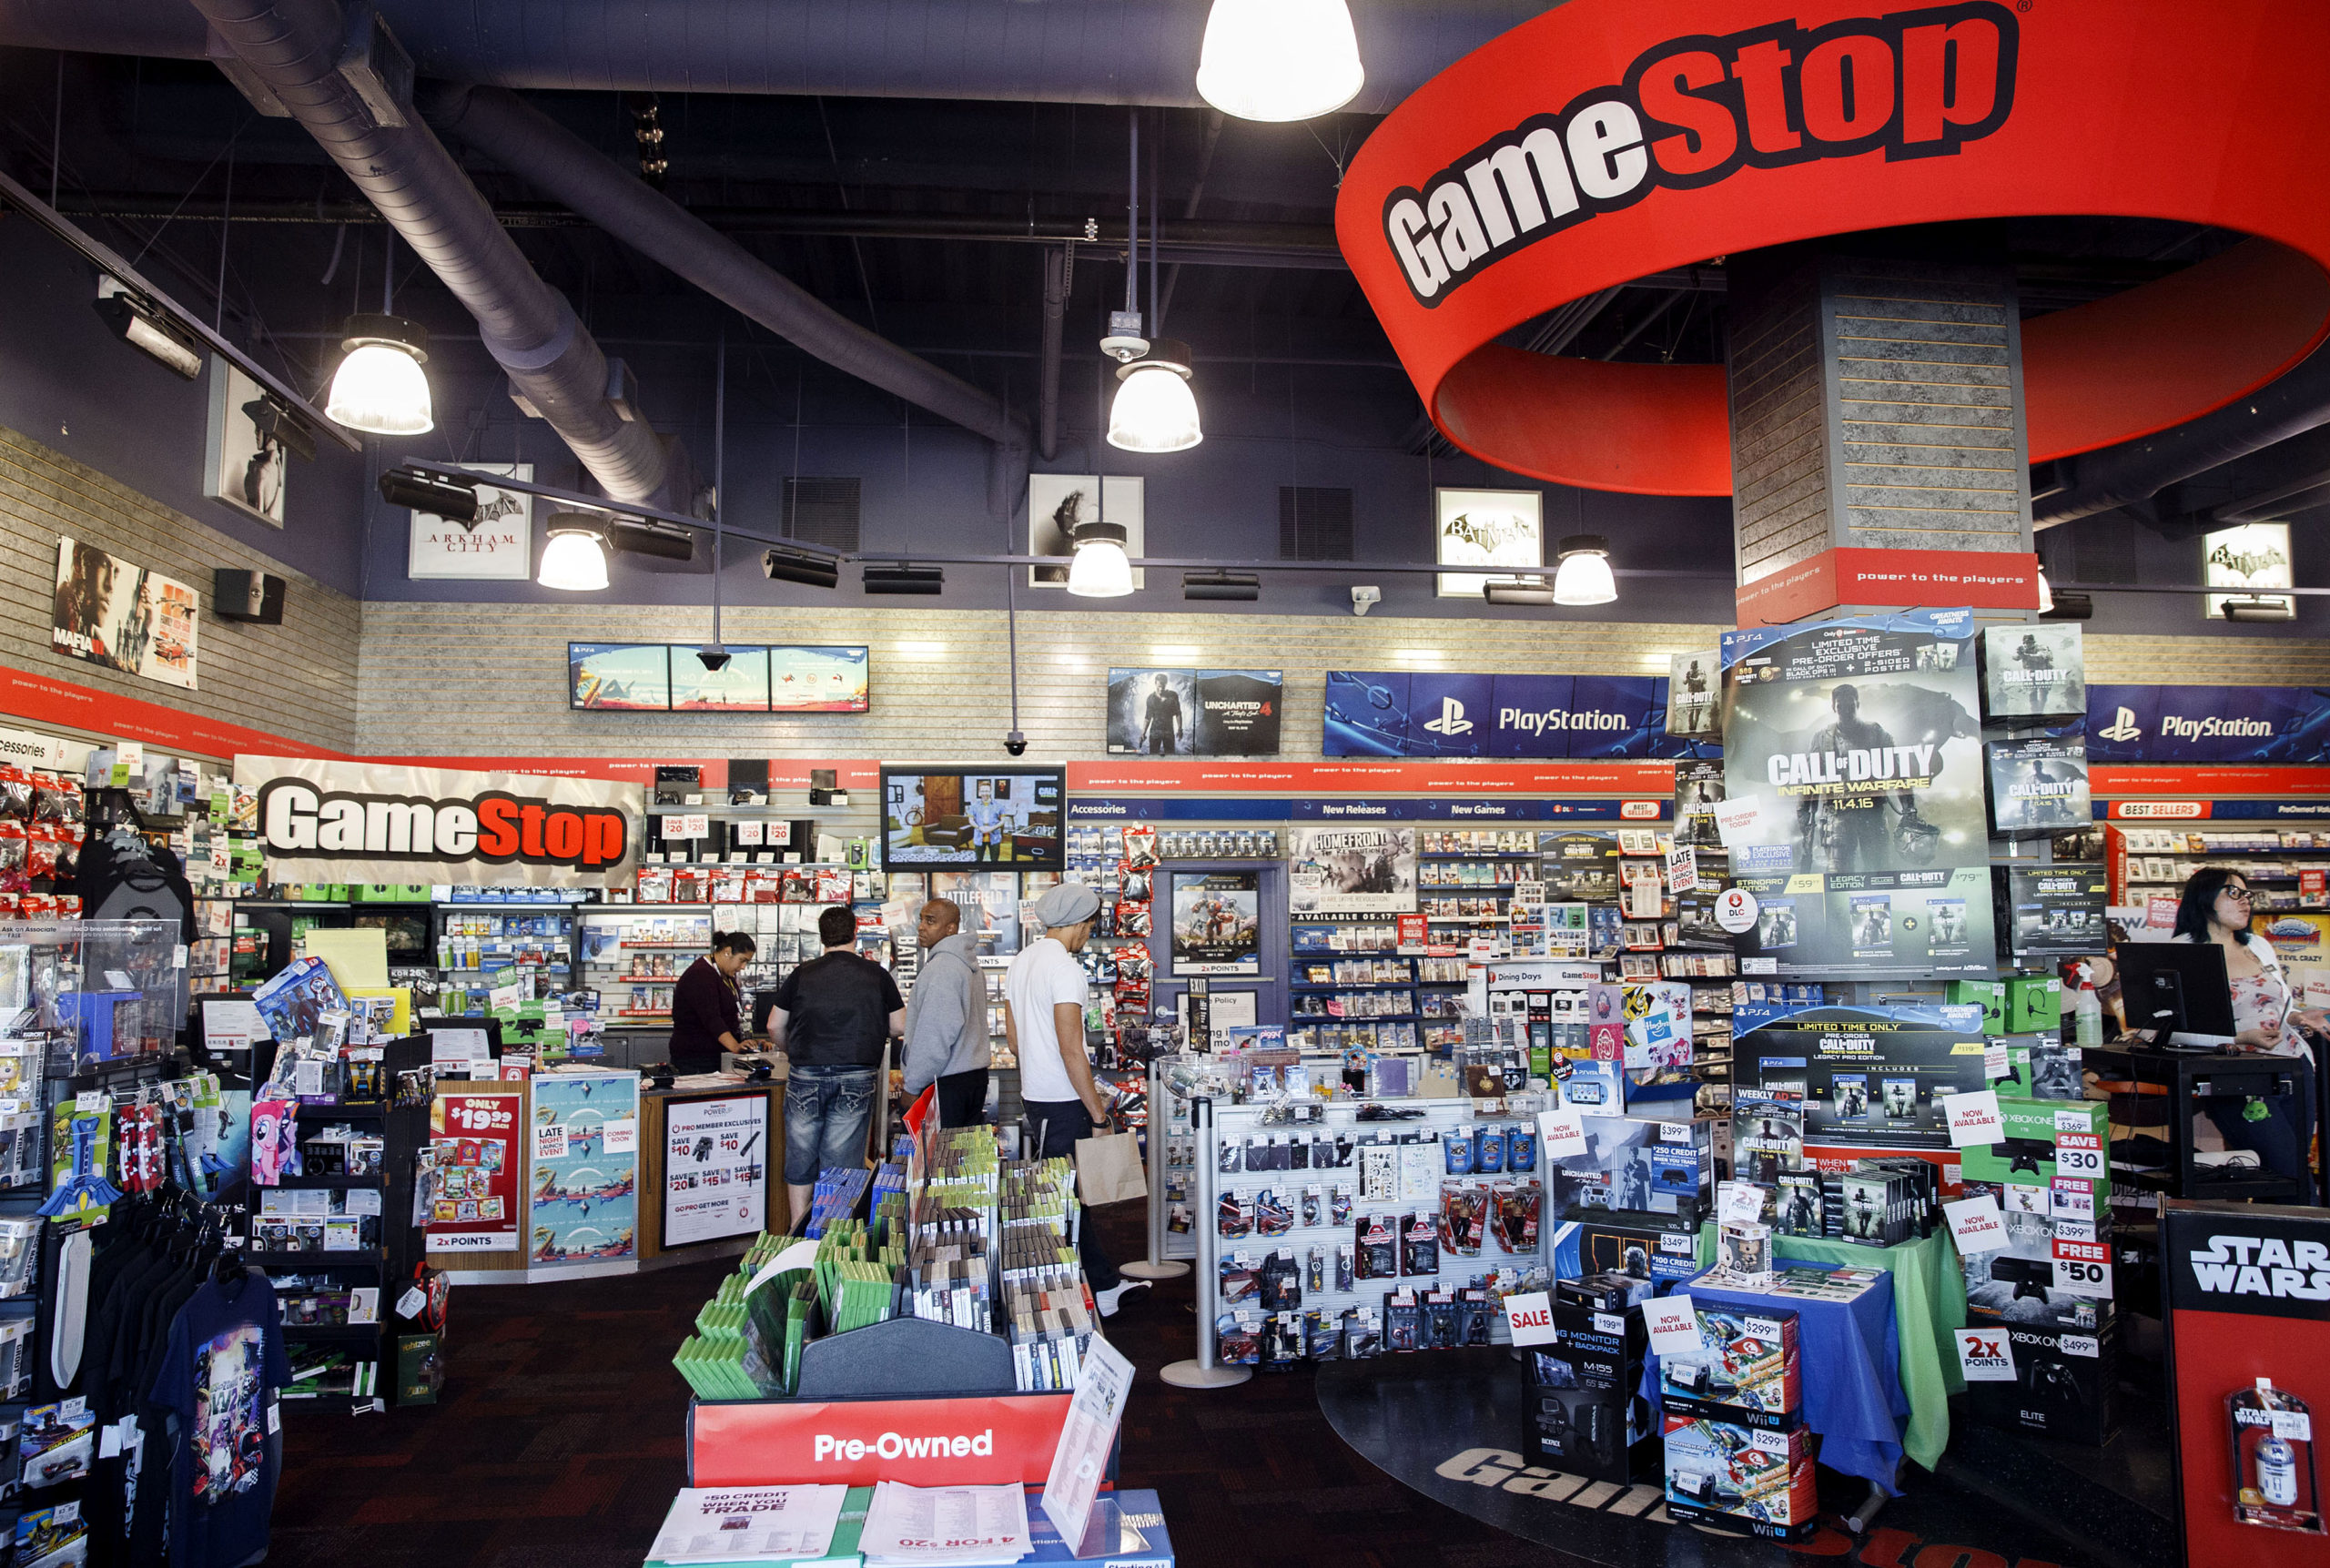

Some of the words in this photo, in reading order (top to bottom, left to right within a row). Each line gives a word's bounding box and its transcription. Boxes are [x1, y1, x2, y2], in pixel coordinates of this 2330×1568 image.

[1388, 16, 2001, 298] GameStop
[429, 533, 516, 544] ARKHAM
[446, 542, 498, 553] CITY
[1857, 572, 1907, 582] power
[1911, 572, 1928, 582] to
[1932, 572, 1958, 582] the
[1962, 574, 2024, 585] players
[1930, 610, 1970, 620] GREATNESS
[1937, 617, 1964, 625] AWAITS
[54, 627, 93, 653] MAFIA
[1736, 632, 1763, 643] PS4
[1811, 639, 1853, 650] LIMITED
[1855, 635, 1880, 645] TIME
[1815, 643, 1878, 656] EXCLUSIVE
[1792, 652, 1854, 666] PRE-ORDER
[1864, 657, 1910, 667] 2-SIDED
[1864, 663, 1910, 673] POSTER
[1786, 670, 1810, 678] BLACK
[12, 678, 37, 690] power
[50, 686, 63, 696] the
[64, 690, 93, 703] players
[1205, 701, 1261, 711] UNCHARTED
[1260, 700, 1272, 716] 4
[1500, 708, 1630, 737] PlayStation
[2162, 714, 2274, 743] PlayStation
[1767, 752, 1836, 786] CALL
[1836, 757, 1849, 770] OF
[1849, 744, 1934, 781] DUTY
[1777, 781, 1845, 797] INFINITE
[1847, 777, 1930, 794] WARFARE
[1070, 804, 1127, 815] Accessories
[1322, 805, 1344, 814] New
[1345, 804, 1387, 814] Releases
[1832, 797, 1874, 811] 11.4.16
[1451, 805, 1471, 814] New
[1473, 805, 1505, 815] Games
[2125, 805, 2150, 815] BEST
[2152, 805, 2194, 815] SELLERS
[1719, 811, 1758, 824] PRE-ORDER
[266, 785, 624, 865] GameStop
[665, 825, 683, 834] $20
[687, 823, 705, 832] $20
[1728, 820, 1753, 829] TODAY
[742, 829, 759, 838] $20
[771, 830, 787, 838] $20
[1313, 831, 1387, 852] HOMEFRONT
[214, 854, 228, 867] 2x
[1669, 849, 1691, 865] LATE
[1752, 851, 1790, 859] EXCLUSIVE
[1671, 862, 1692, 875] NIGHT
[1672, 870, 1694, 882] LAUNCH
[1829, 875, 1866, 884] LEGACY
[1673, 876, 1695, 890] EVENT
[1736, 878, 1784, 886] STANDARD
[1829, 881, 1865, 889] EDITION
[939, 890, 1005, 905] BATTLEFIELD
[1297, 913, 1358, 921] AVAILABLE
[1728, 908, 1745, 916] DLC
[1498, 972, 1520, 983] Dining
[1521, 972, 1542, 982] Days
[1561, 971, 1599, 981] GameStop
[1190, 977, 1207, 993] EXIT
[1214, 996, 1237, 1006] Policy
[1748, 1008, 1770, 1017] PS4
[1645, 1019, 1671, 1034] Hasbro
[1798, 1023, 1839, 1031] LIMITED
[1841, 1023, 1869, 1031] TIME
[1737, 1090, 1774, 1100] WEEKLY
[1774, 1092, 1789, 1100] AD
[465, 1098, 501, 1109] ONLY
[1962, 1109, 1983, 1118] NOW
[695, 1122, 724, 1130] MEMBER
[724, 1118, 762, 1128] EXCLUSIVES
[1953, 1117, 1996, 1128] AVAILABLE
[2008, 1114, 2032, 1124] XBOX
[2032, 1116, 2054, 1126] ONE
[539, 1128, 563, 1138] LATE
[606, 1129, 633, 1138] COMING
[1554, 1125, 1570, 1133] NOW
[539, 1136, 564, 1146] NIGHT
[611, 1136, 630, 1144] SOON
[720, 1132, 739, 1140] SAVE
[1547, 1130, 1581, 1141] AVAILABLE
[539, 1143, 564, 1151] LAUNCH
[672, 1138, 691, 1146] SAVE
[720, 1139, 738, 1151] $10
[2060, 1136, 2097, 1148] SAVE
[539, 1148, 564, 1157] EVENT
[672, 1145, 690, 1157] $10
[1653, 1146, 1669, 1155] $250
[1670, 1147, 1697, 1158] CREDIT
[1818, 1158, 1847, 1167] WHEN
[2061, 1152, 2098, 1169] $30
[702, 1168, 720, 1178] SAVE
[734, 1165, 752, 1173] SAVE
[1561, 1169, 1603, 1180] UNCHARTED
[669, 1173, 688, 1181] SAVE
[702, 1177, 719, 1187] $15
[734, 1172, 751, 1182] $15
[669, 1180, 688, 1191] $20
[2054, 1179, 2089, 1191] FREE
[698, 1201, 711, 1209] GET
[711, 1199, 729, 1208] MORE
[1964, 1215, 1985, 1225] NOW
[1958, 1220, 1999, 1235] AVAILABLE
[2010, 1224, 2040, 1236] XBOX
[2041, 1227, 2057, 1237] ON
[436, 1238, 451, 1247] 2x
[451, 1237, 491, 1246] POINTS
[2059, 1242, 2103, 1259] FREE
[2190, 1235, 2330, 1270] STAR
[1652, 1256, 1668, 1265] $100
[1669, 1259, 1696, 1269] CREDIT
[2061, 1261, 2103, 1283] $50
[2191, 1262, 2330, 1300] WARS
[1512, 1310, 1550, 1330] SALE
[1660, 1315, 1680, 1324] NOW
[1653, 1322, 1692, 1334] AVAILABLE
[2011, 1331, 2042, 1344] XBOX
[2043, 1337, 2061, 1348] ON
[1575, 1341, 1620, 1355] BACKPACK
[1965, 1336, 2002, 1358] 2x
[1965, 1357, 2009, 1367] POINTS
[2020, 1410, 2045, 1421] ELITE
[47, 1428, 89, 1452] STAR-LORD
[815, 1428, 993, 1462] Pre-Owned
[1541, 1437, 1561, 1447] BACKPACK
[704, 1493, 730, 1502] $50
[733, 1491, 789, 1501] CREDIT
[755, 1498, 787, 1506] YOU
[700, 1502, 785, 1515] TRADE
[898, 1538, 938, 1547] $20
[945, 1538, 993, 1547] FOR
